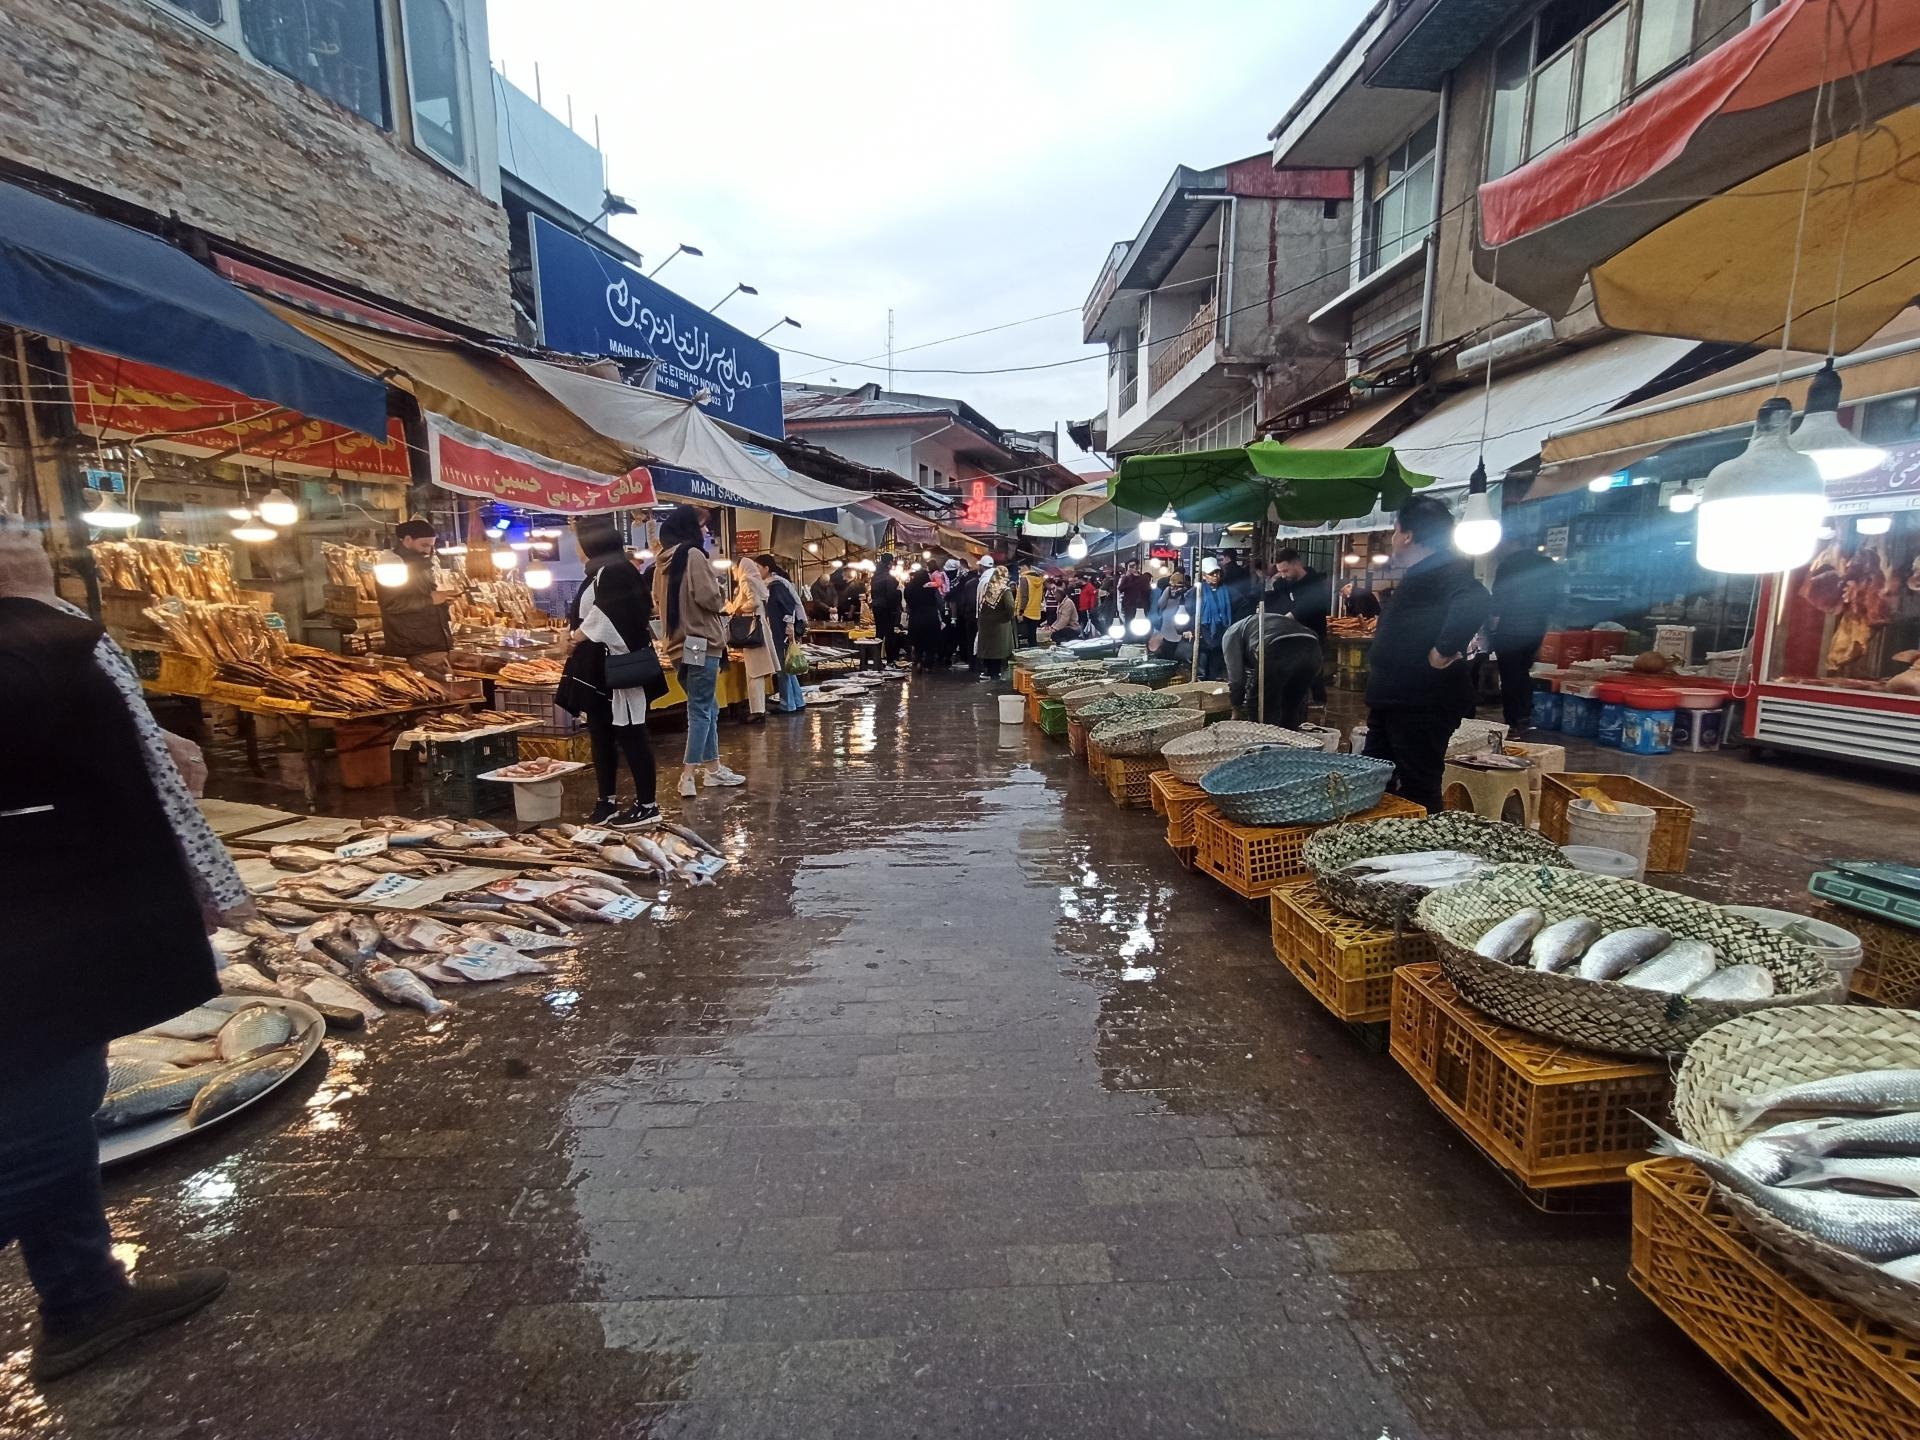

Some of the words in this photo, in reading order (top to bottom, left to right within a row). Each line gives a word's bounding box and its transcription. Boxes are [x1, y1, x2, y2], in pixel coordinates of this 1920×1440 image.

[609, 338, 633, 357] MAHI
[669, 364, 699, 386] ETEHAD
[606, 473, 643, 504] ماهی
[691, 479, 716, 498] MAHI
